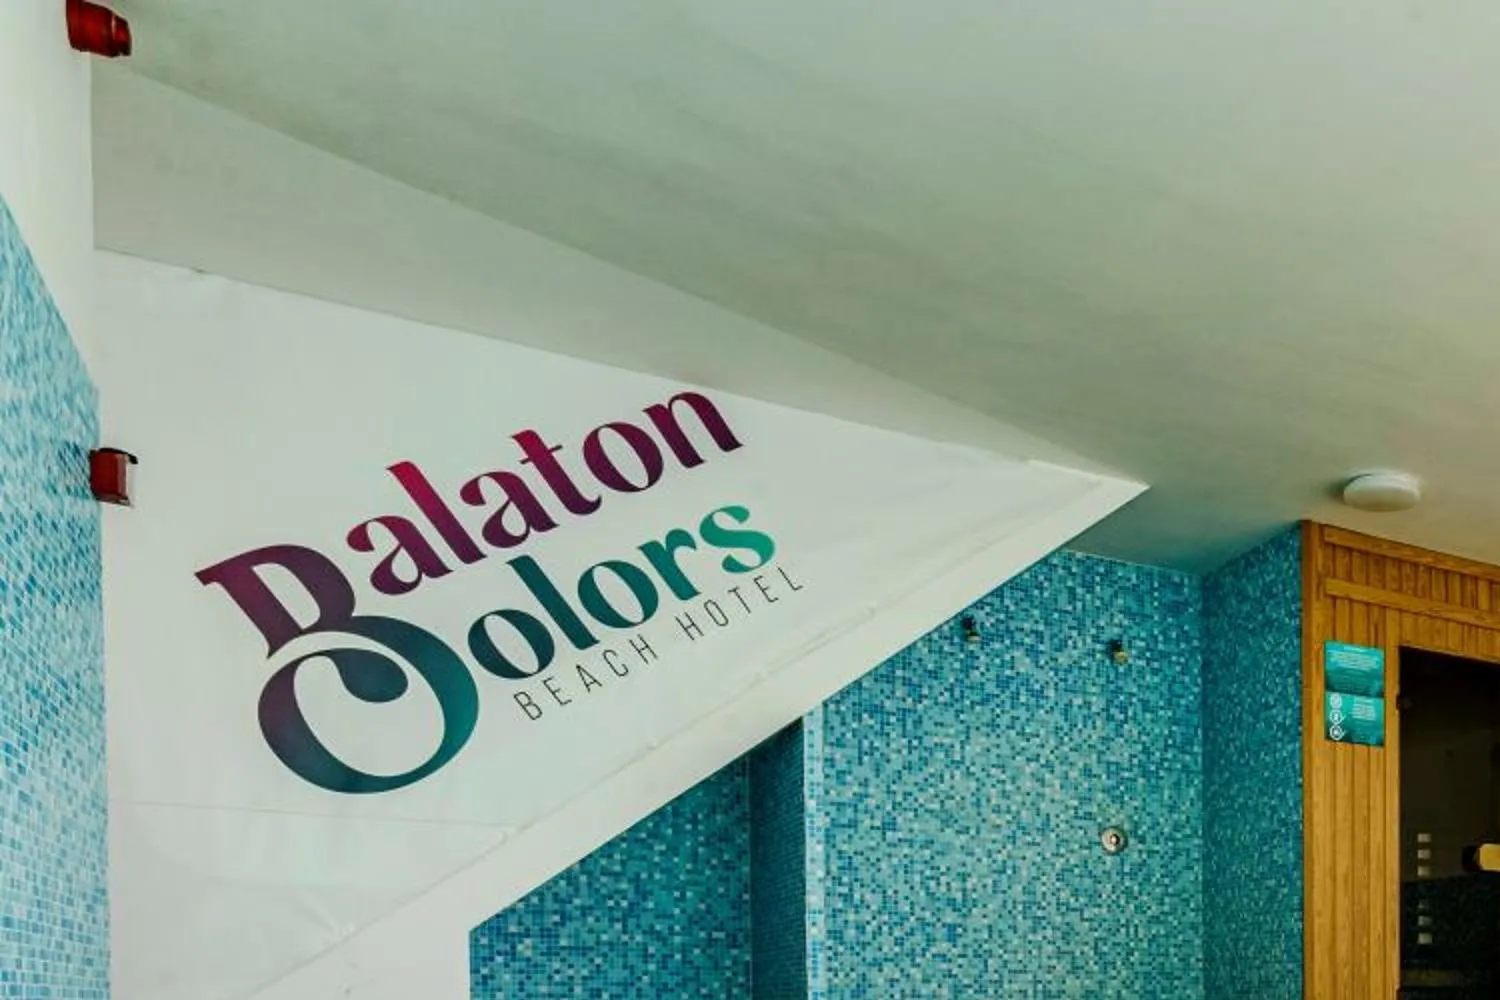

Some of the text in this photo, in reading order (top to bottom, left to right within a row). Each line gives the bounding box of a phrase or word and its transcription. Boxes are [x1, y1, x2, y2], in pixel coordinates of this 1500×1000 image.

[194, 391, 743, 658] Balaton
[513, 565, 805, 721] BEACH HOTEL
